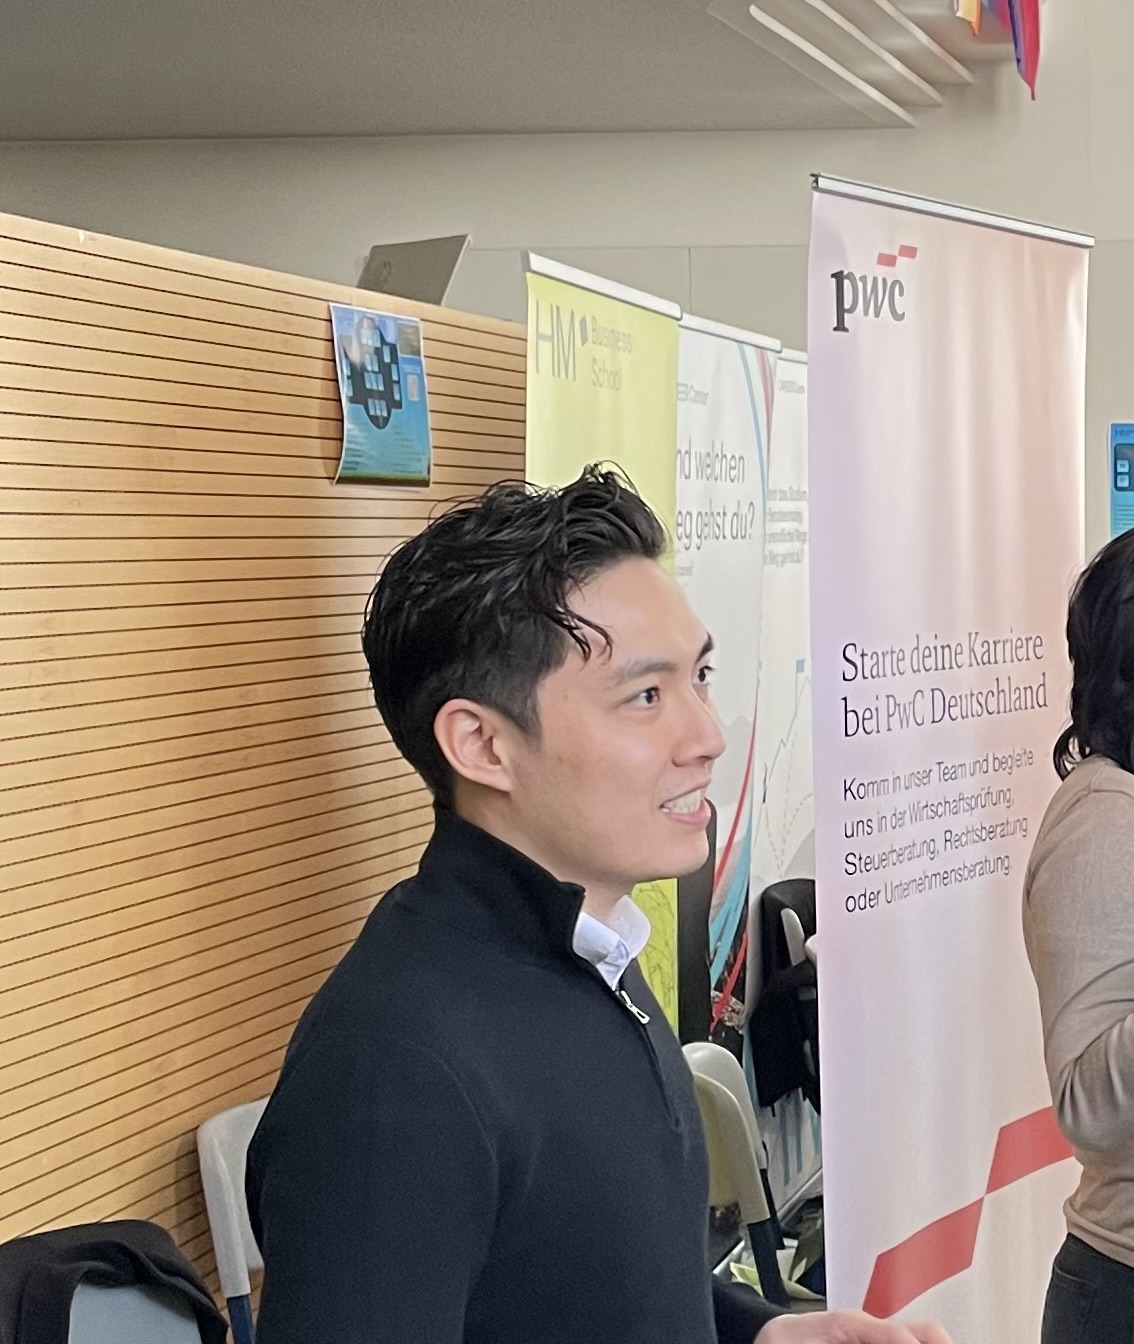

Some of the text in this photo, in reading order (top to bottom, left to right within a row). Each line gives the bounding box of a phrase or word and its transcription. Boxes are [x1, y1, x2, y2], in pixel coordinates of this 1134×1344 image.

[830, 269, 906, 333] pwc
[535, 300, 576, 382] HM
[592, 315, 632, 354] Business
[592, 357, 623, 392] School
[695, 439, 745, 484] welchen
[695, 498, 727, 551] gehst
[730, 499, 755, 541] du?
[842, 627, 1044, 682] Starte deine Karriere
[841, 671, 1048, 738] bei PwC Deutschland
[843, 747, 1034, 802] Komm in unser Team und begleite
[844, 785, 1014, 839] uns in der Wirtschaftsprüfung,
[844, 816, 1028, 876] Steuerberatung, Rechtsberatung
[845, 854, 1013, 913] oder Unternehmensberatung.
